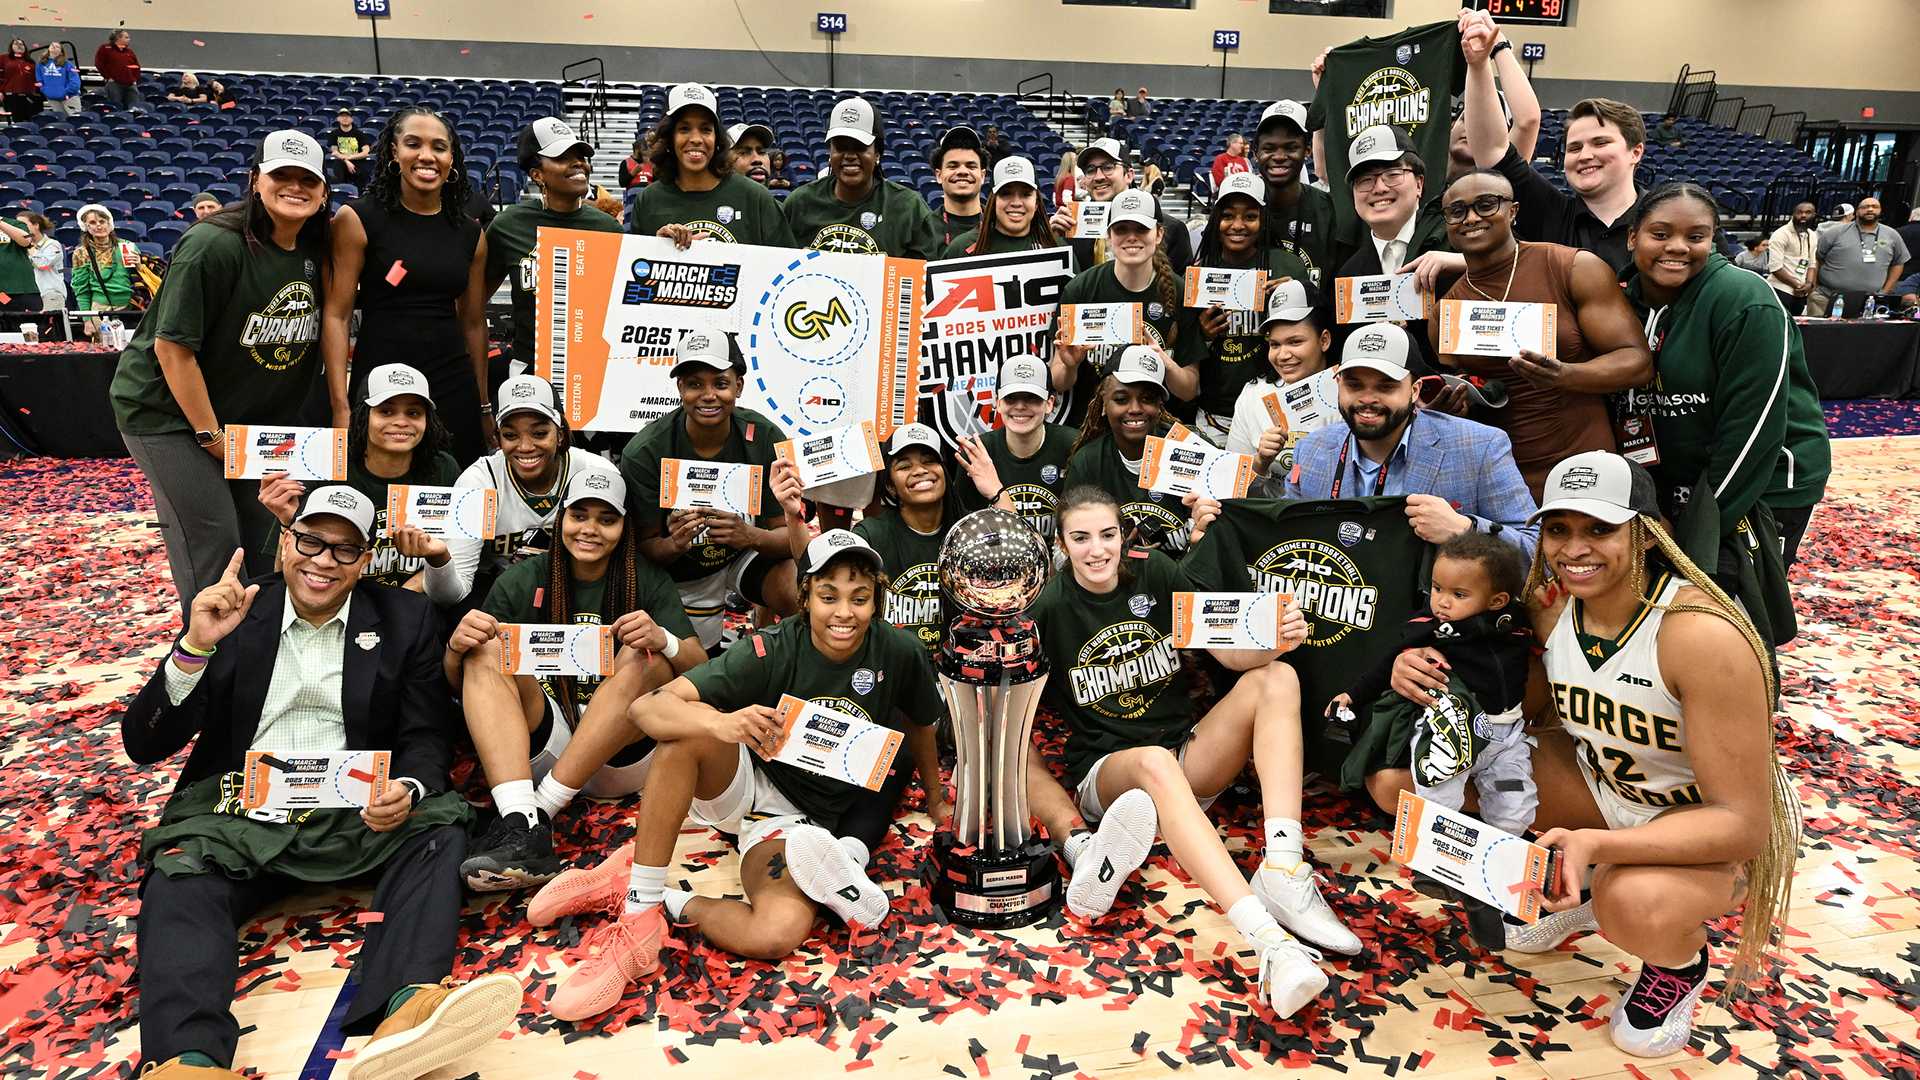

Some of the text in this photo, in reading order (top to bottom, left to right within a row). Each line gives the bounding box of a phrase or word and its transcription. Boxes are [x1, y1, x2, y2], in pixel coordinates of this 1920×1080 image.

[358, 0, 385, 11] 315
[1542, 0, 1559, 16] 58
[820, 16, 844, 28] 314
[1216, 33, 1237, 45] 313
[1524, 47, 1543, 57] 312
[1368, 84, 1400, 96] A10
[1347, 89, 1429, 138] CHAMPIONS
[826, 238, 858, 249] A10
[576, 240, 585, 276] SEAT 25
[650, 263, 710, 283] MARCH
[656, 281, 736, 302] MADNESS
[923, 274, 1075, 318] A10
[282, 300, 308, 311] A10
[575, 309, 584, 343] ROW 16
[784, 296, 852, 341] GM
[241, 310, 320, 346] CHAMPIONS
[621, 325, 672, 345] 2025
[945, 320, 986, 337] 2025
[879, 265, 896, 436] NCAA TOURNAMENT AUTOMATIC QUALIFIER
[573, 374, 582, 421] SECTION 3
[805, 396, 840, 406] A10
[1655, 393, 1706, 407] MASON
[1624, 438, 1645, 448] MARCH
[1178, 448, 1196, 457] MARCH
[1184, 466, 1200, 475] TICKET
[1562, 474, 1598, 484] CHAMPIONS
[1259, 542, 1359, 582] 2025 WOMEN'S BASKETBALL
[1282, 557, 1332, 576] A10
[918, 627, 940, 642] GM
[1080, 623, 1156, 663] 2025 WOMEN'S BASKETBALL
[1101, 639, 1142, 659] A10
[1070, 636, 1181, 706] CHAMPIONS
[1616, 672, 1652, 688] A10
[1119, 693, 1144, 708] GM
[820, 716, 839, 727] MARCH
[1550, 682, 1682, 752] EORGE
[818, 721, 846, 737] MADNESS
[803, 733, 840, 748] 2025 TICKET
[1443, 818, 1467, 833] MARCH
[1444, 827, 1477, 846] MADNESS
[1432, 838, 1473, 861] 2025 TICKET
[989, 899, 1026, 908] CHAMPION
